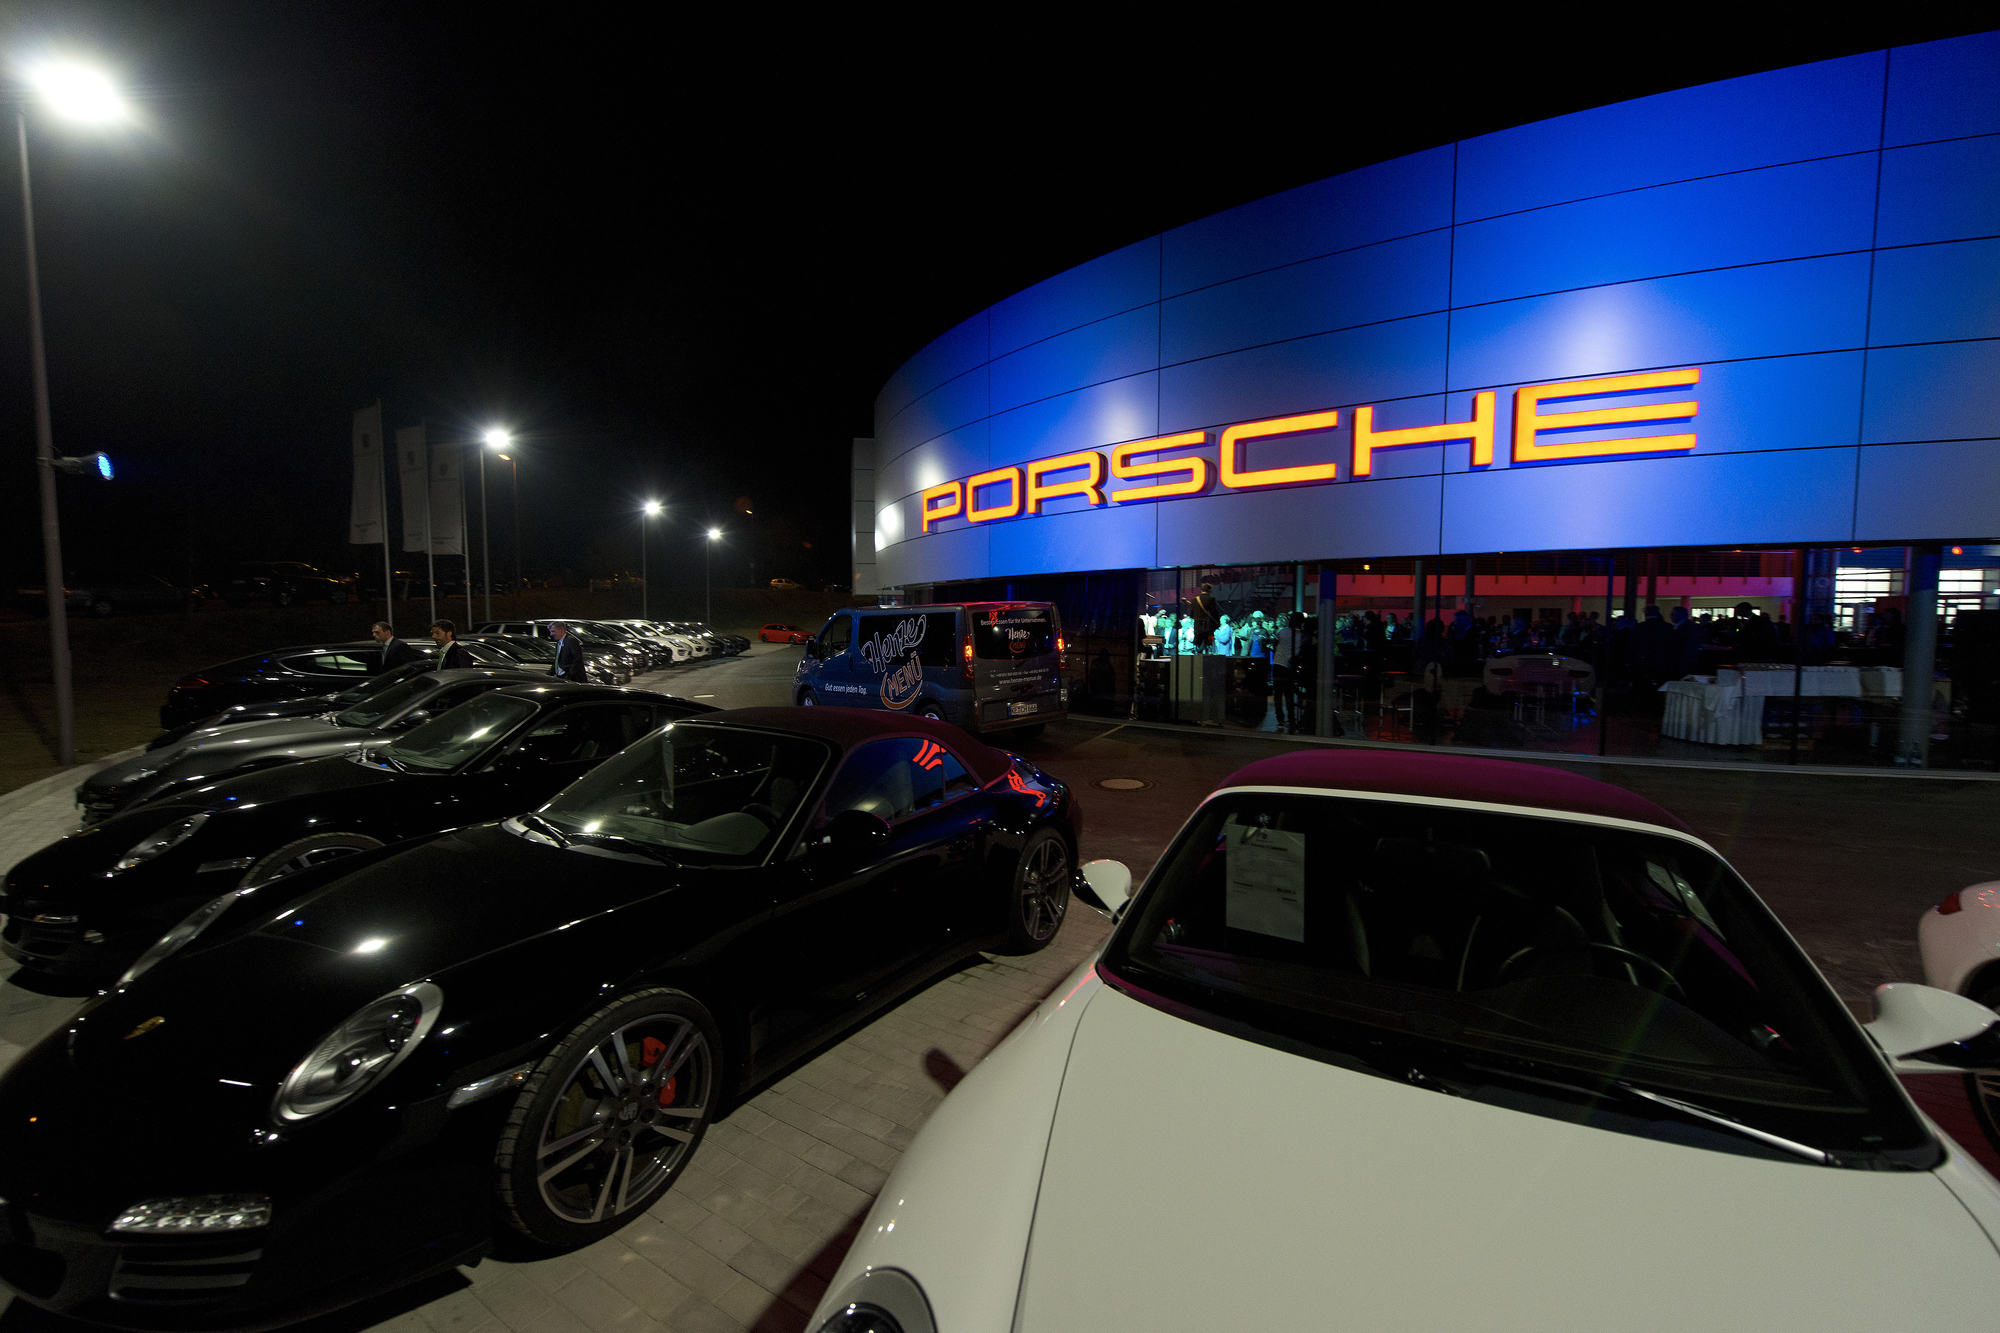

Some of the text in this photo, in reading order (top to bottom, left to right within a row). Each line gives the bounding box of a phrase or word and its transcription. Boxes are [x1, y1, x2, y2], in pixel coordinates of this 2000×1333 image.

[922, 367, 1701, 533] PORSCHE
[861, 614, 926, 674] Henze
[1004, 627, 1031, 640] Henze
[825, 683, 833, 692] Gut
[846, 685, 858, 694] jeden
[887, 650, 923, 701] MENÜ
